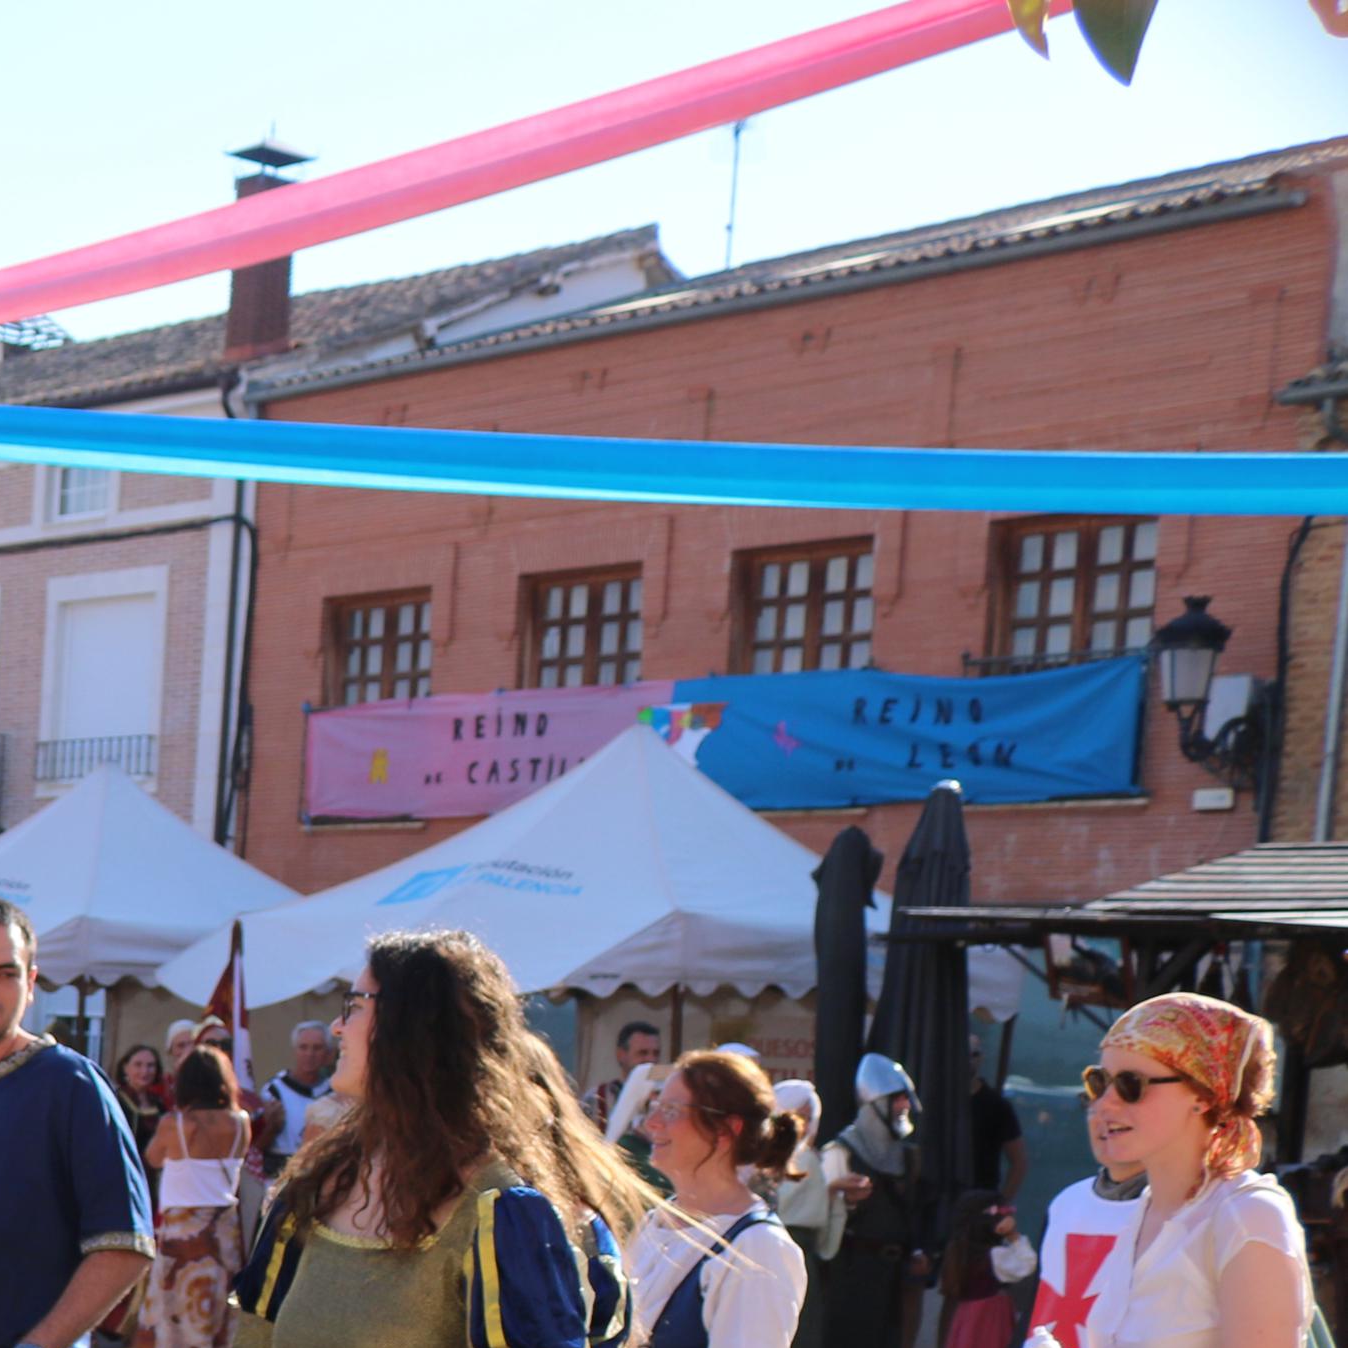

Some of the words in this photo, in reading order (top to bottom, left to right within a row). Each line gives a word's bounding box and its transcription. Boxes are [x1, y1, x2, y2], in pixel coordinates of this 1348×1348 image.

[452, 708, 549, 742] REINO
[852, 694, 983, 725] REINO
[466, 755, 585, 785] CASTIL
